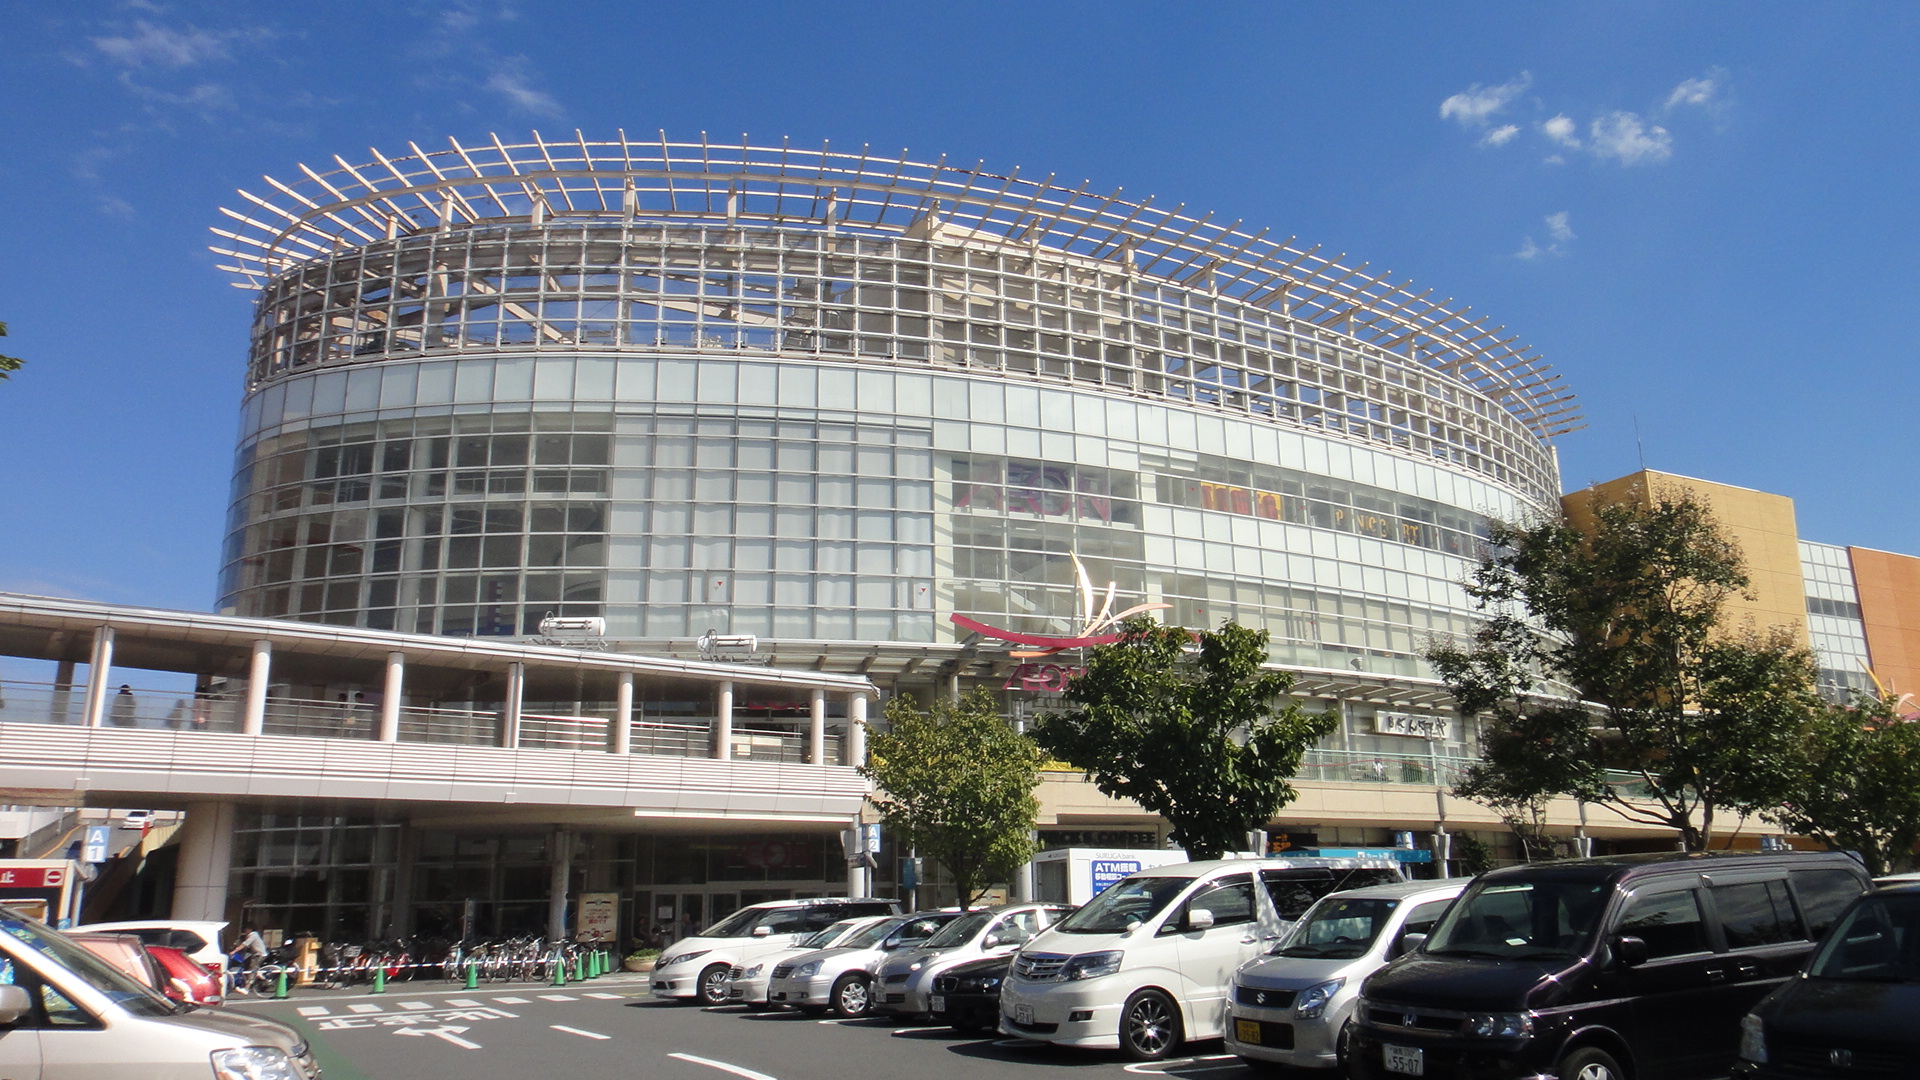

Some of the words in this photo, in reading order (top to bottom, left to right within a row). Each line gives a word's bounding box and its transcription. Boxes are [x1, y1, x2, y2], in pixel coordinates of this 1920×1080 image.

[89, 829, 104, 843] A
[868, 826, 878, 837] A
[870, 840, 877, 850] 2
[91, 847, 99, 860] 1
[1392, 1056, 1419, 1072] 55-07
